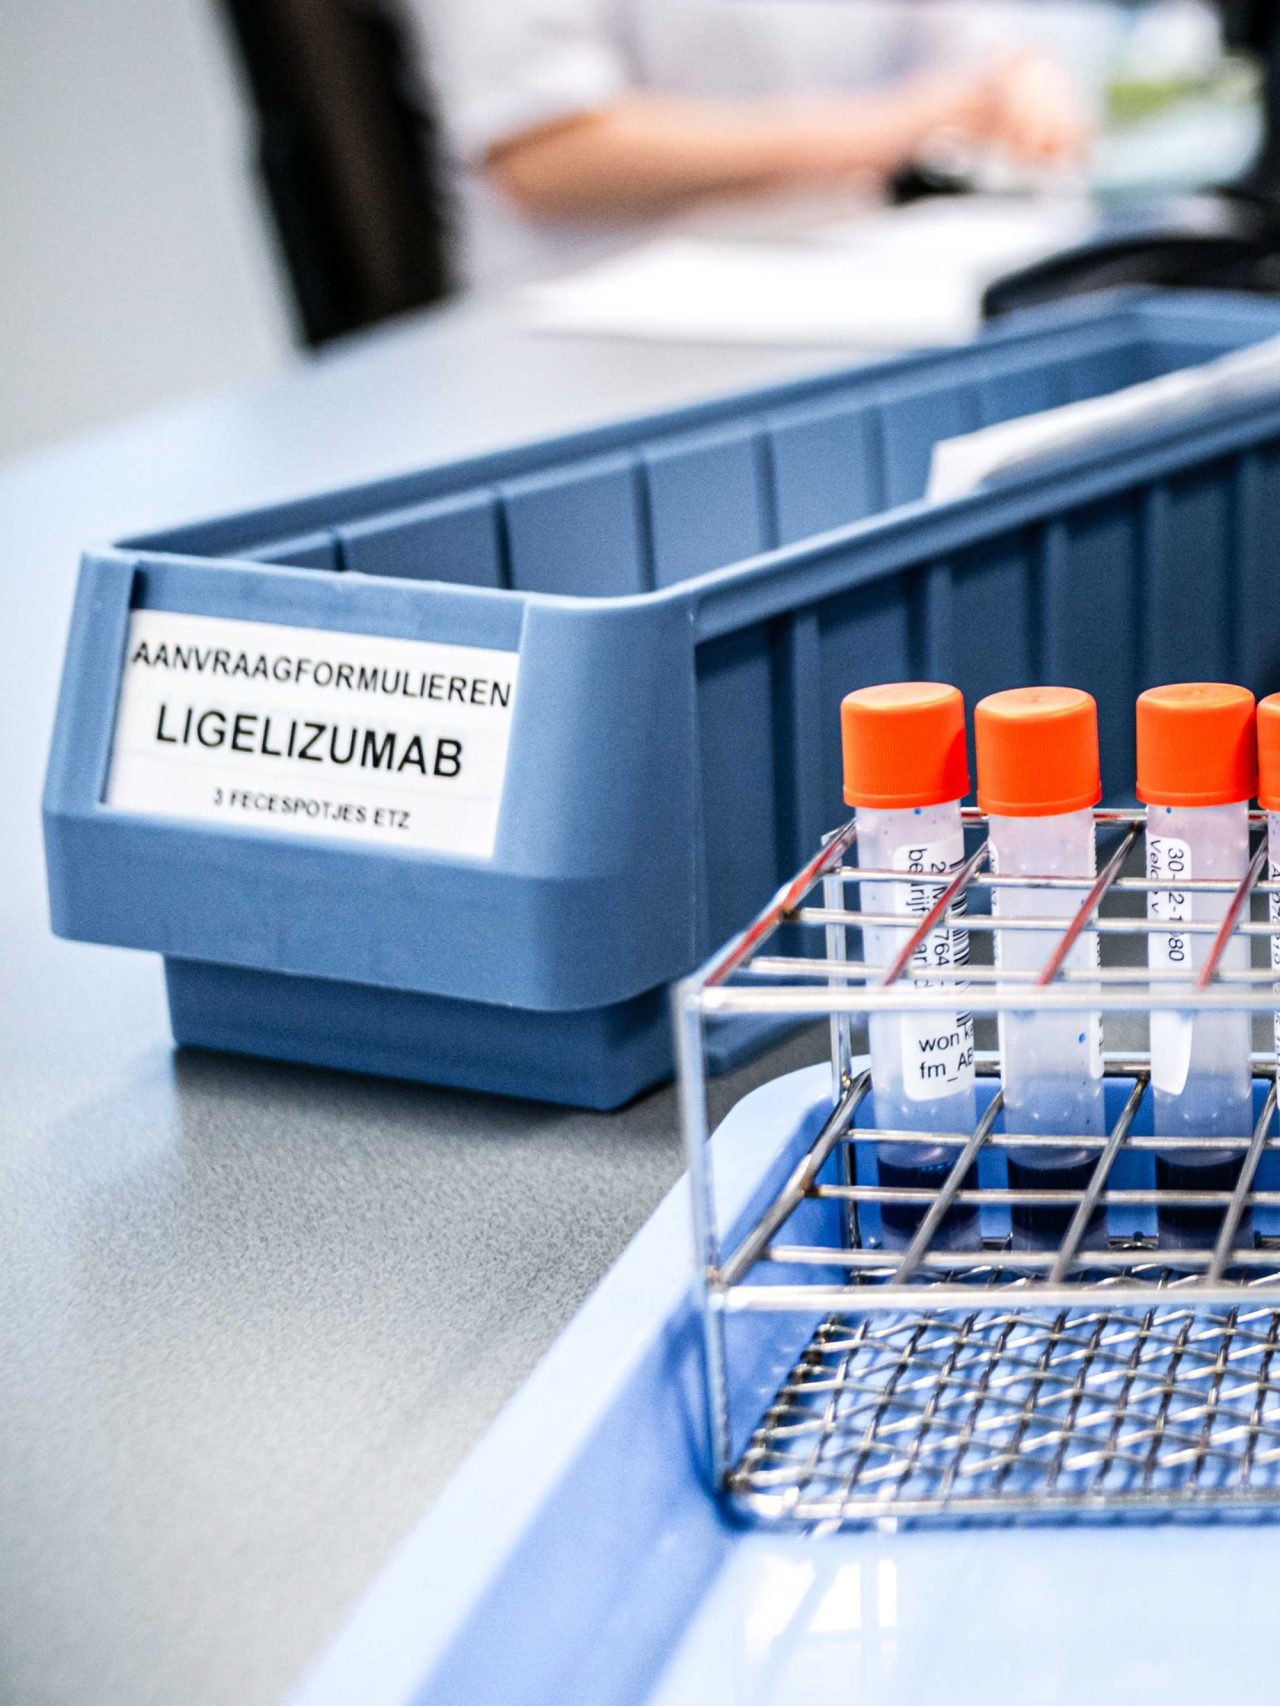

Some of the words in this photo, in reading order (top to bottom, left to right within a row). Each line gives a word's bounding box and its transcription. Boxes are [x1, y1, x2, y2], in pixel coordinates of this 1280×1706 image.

[132, 641, 511, 708] AANVRAAGFORMULIEREN
[156, 703, 463, 779] LIGELIZUMAB
[212, 787, 224, 807] 3
[230, 790, 367, 824] FECESPOTJES
[374, 808, 411, 830] ETZ
[918, 1031, 960, 1052] won
[919, 1047, 974, 1083] fm_AB
